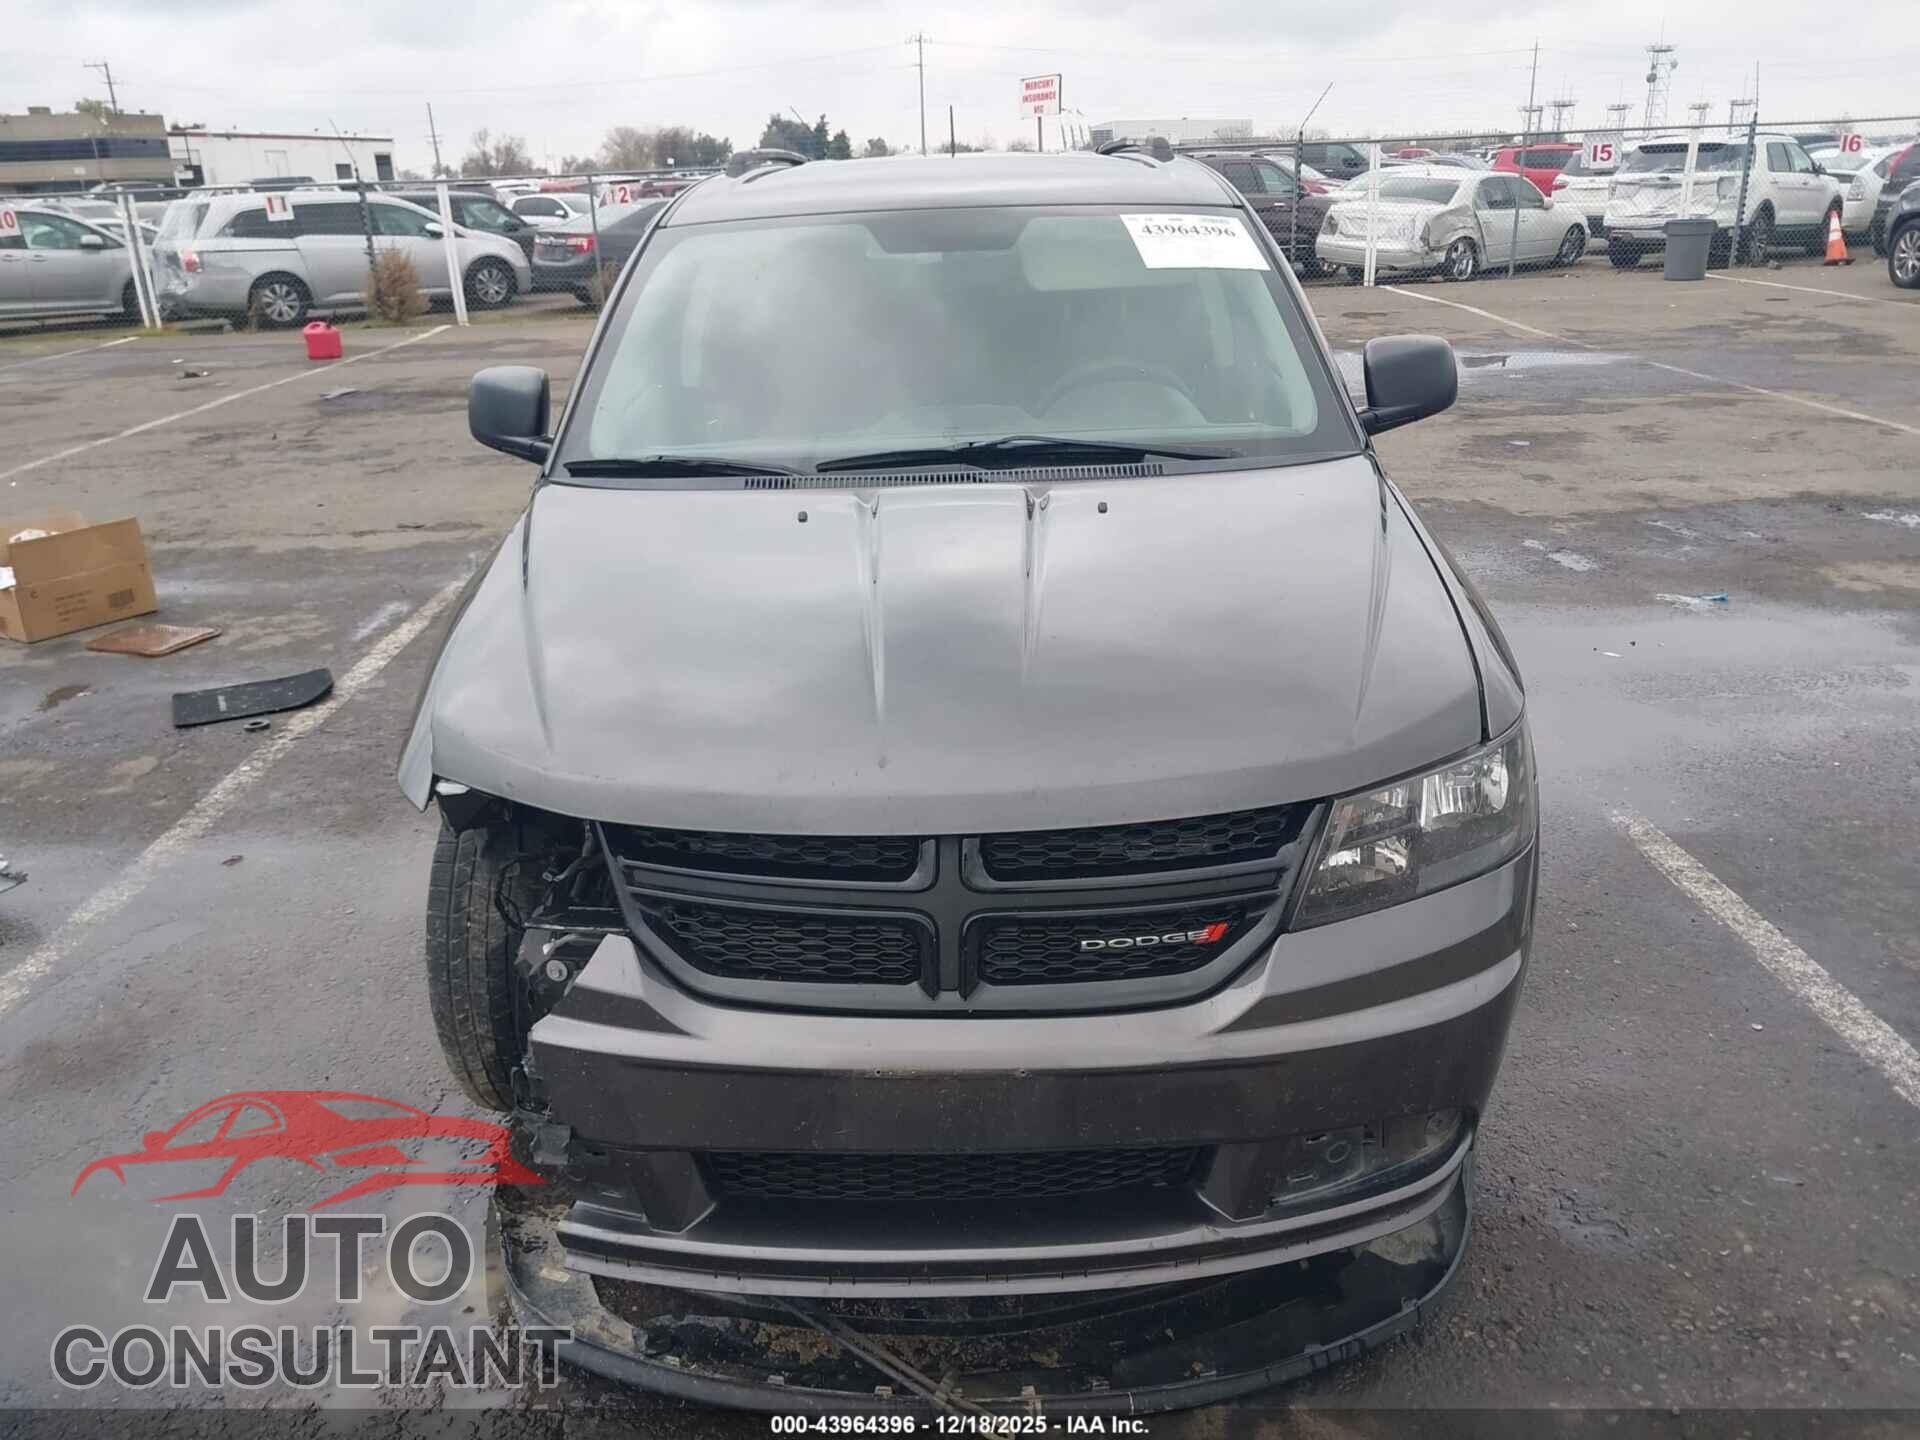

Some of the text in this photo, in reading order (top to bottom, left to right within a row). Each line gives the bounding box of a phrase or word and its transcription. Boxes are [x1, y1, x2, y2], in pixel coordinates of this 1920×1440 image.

[1022, 91, 1056, 103] INSURANCE
[1841, 134, 1862, 152] 16
[1591, 143, 1613, 162] 15
[610, 186, 629, 203] 12
[0, 211, 15, 228] 0
[1141, 223, 1236, 238] 43964396
[1081, 928, 1209, 951] DODGE
